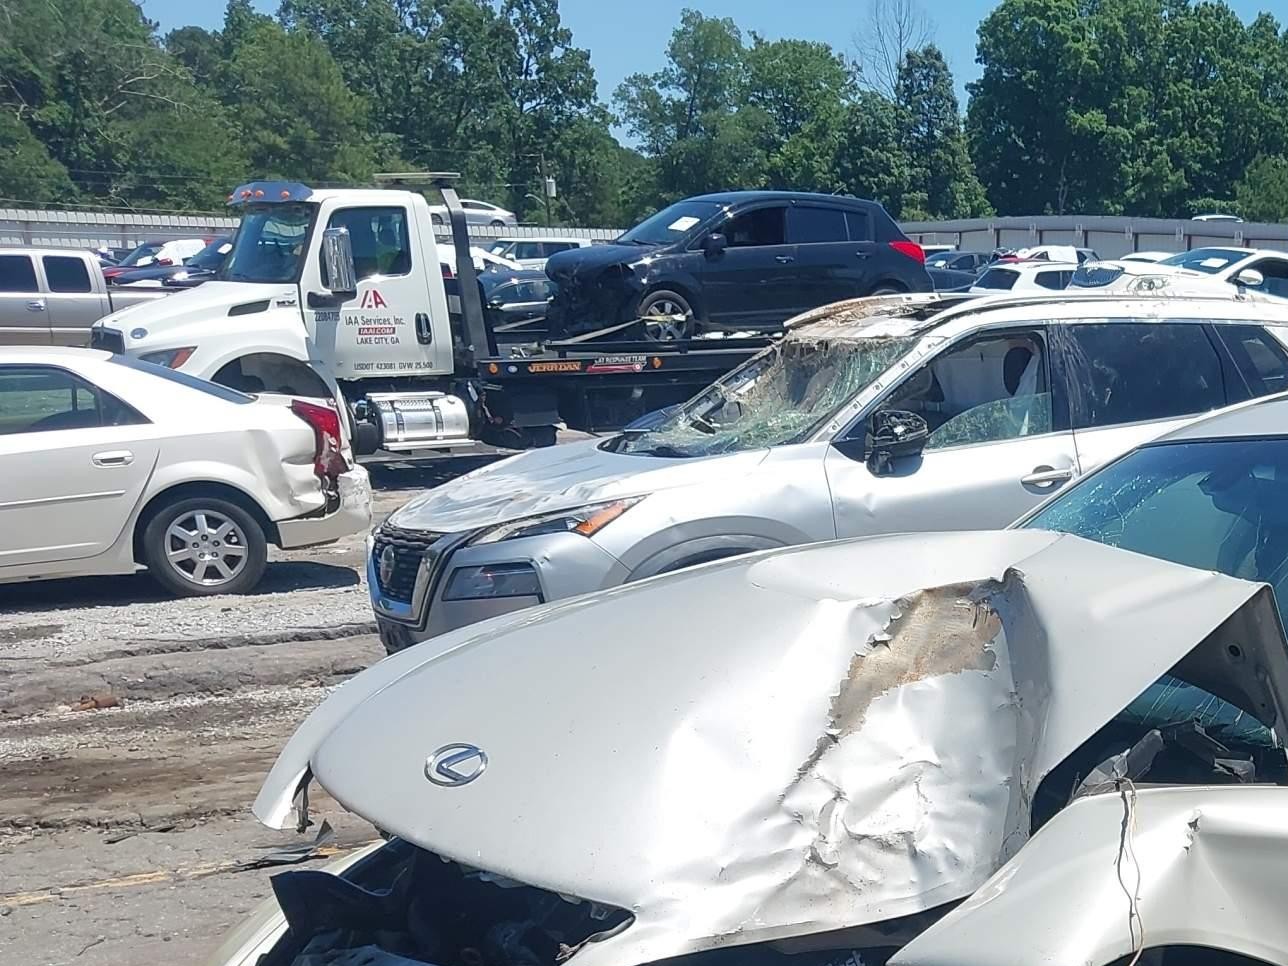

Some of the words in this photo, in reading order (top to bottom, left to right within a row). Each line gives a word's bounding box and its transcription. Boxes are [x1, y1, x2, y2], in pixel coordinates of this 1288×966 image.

[345, 315, 360, 326] IAA
[361, 315, 393, 326] Services,
[393, 315, 406, 325] Inc.
[356, 337, 374, 345] LAKE
[390, 337, 400, 345] GA
